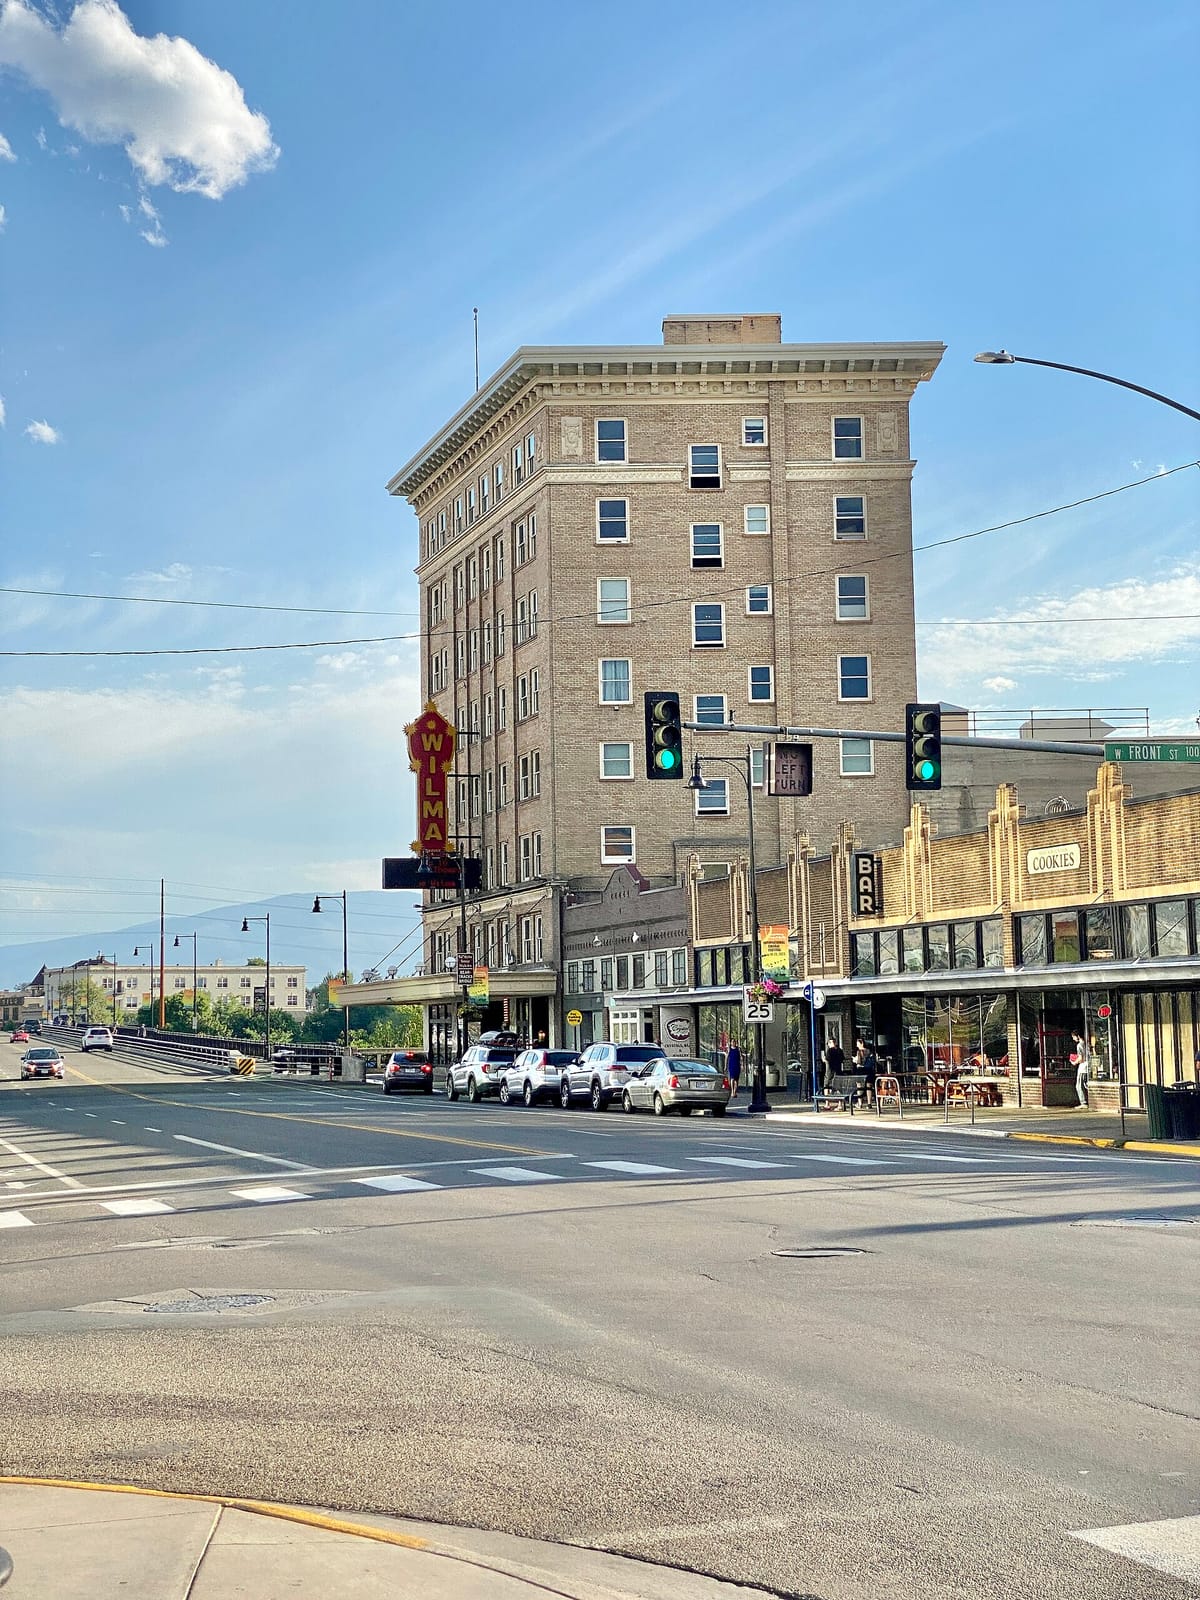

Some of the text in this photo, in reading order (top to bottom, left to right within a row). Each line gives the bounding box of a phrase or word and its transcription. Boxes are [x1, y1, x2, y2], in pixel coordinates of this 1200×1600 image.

[780, 751, 799, 760] NO
[1114, 745, 1200, 760] W FRONT ST 100
[421, 733, 444, 841] WILMA
[1032, 851, 1075, 871] COOKIES
[858, 857, 874, 912] BAR
[747, 1004, 770, 1019] 25
